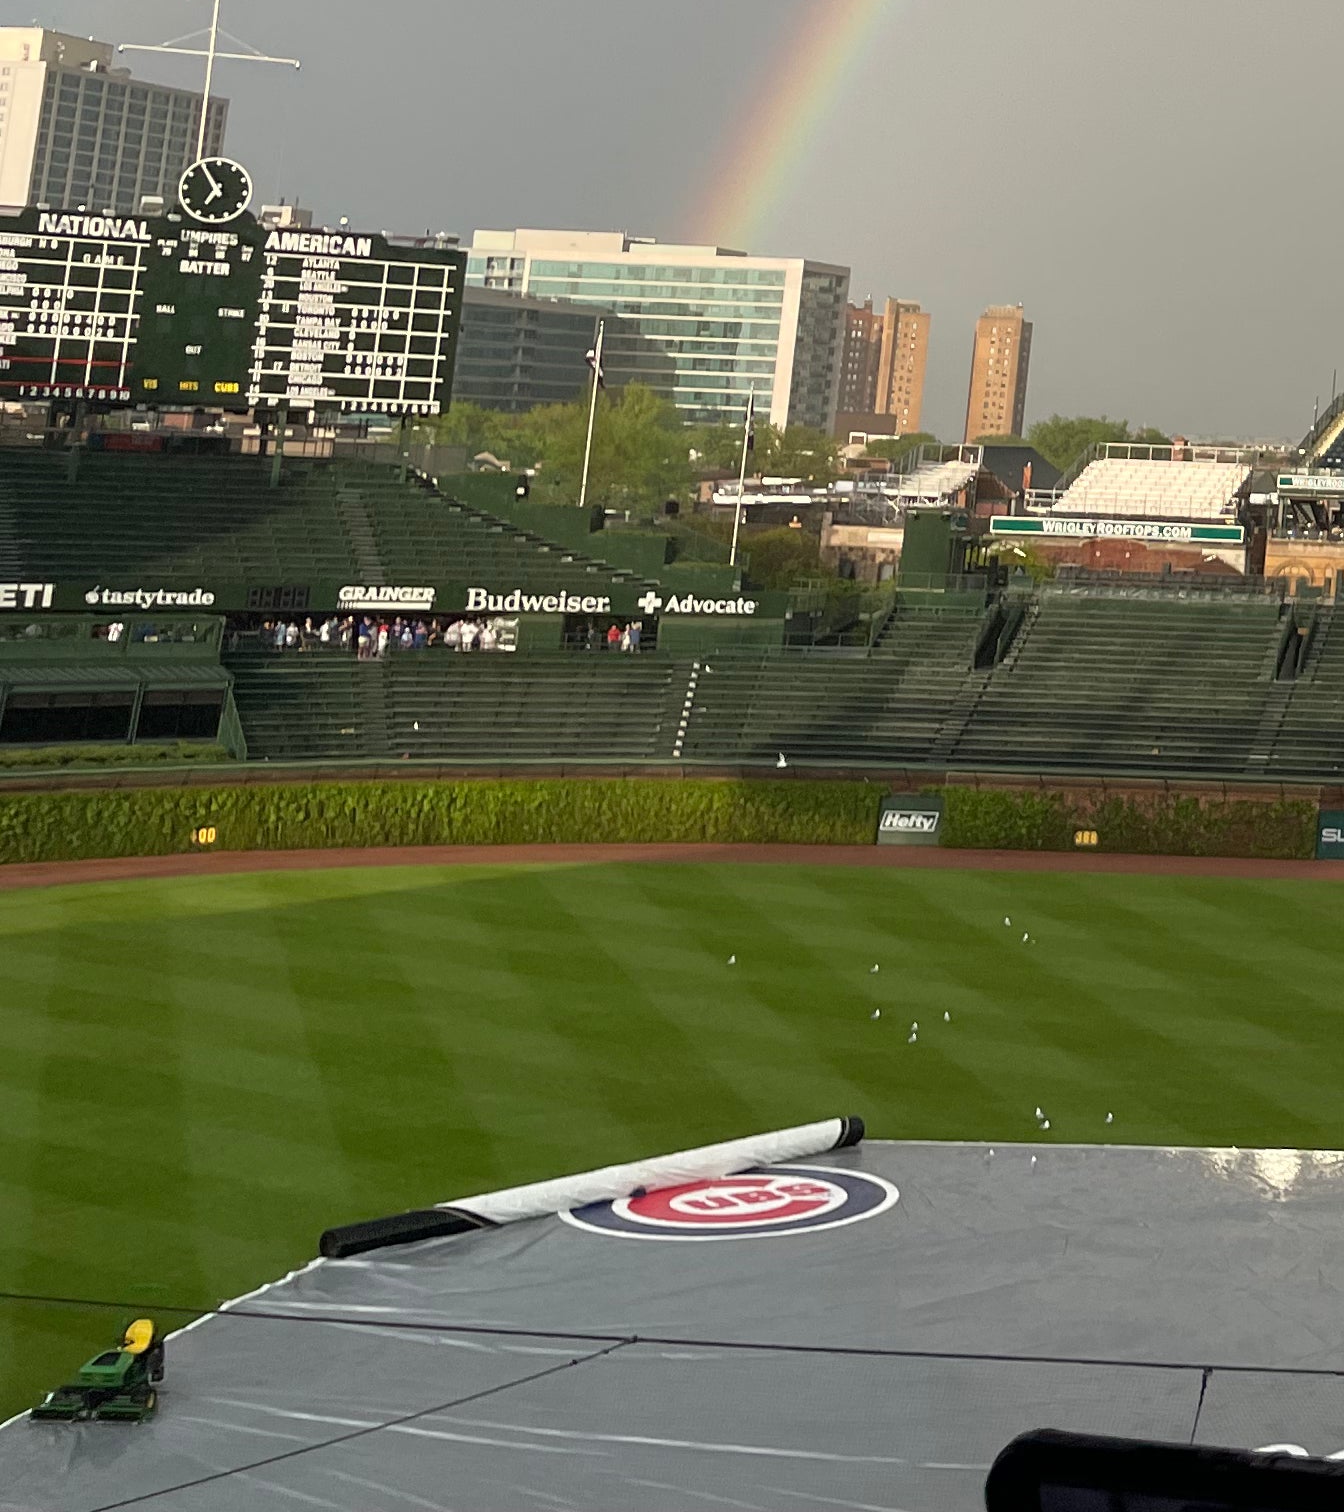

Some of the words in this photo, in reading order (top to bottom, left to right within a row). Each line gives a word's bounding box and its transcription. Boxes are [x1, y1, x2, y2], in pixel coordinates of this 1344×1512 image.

[38, 212, 152, 240] NATIONAL
[181, 229, 238, 246] UMPIRES
[264, 231, 372, 257] AMERICAN
[180, 259, 230, 276] BATTER
[215, 382, 239, 393] CUBS
[1042, 520, 1192, 539] WRIGLEYROOFTOPS.COM
[0, 583, 55, 608] ETI
[102, 588, 215, 609] tastytrade
[339, 586, 435, 603] GRAINGER
[466, 588, 610, 614] Budweiser
[664, 594, 756, 615] Advocate
[884, 812, 934, 830] Hefty
